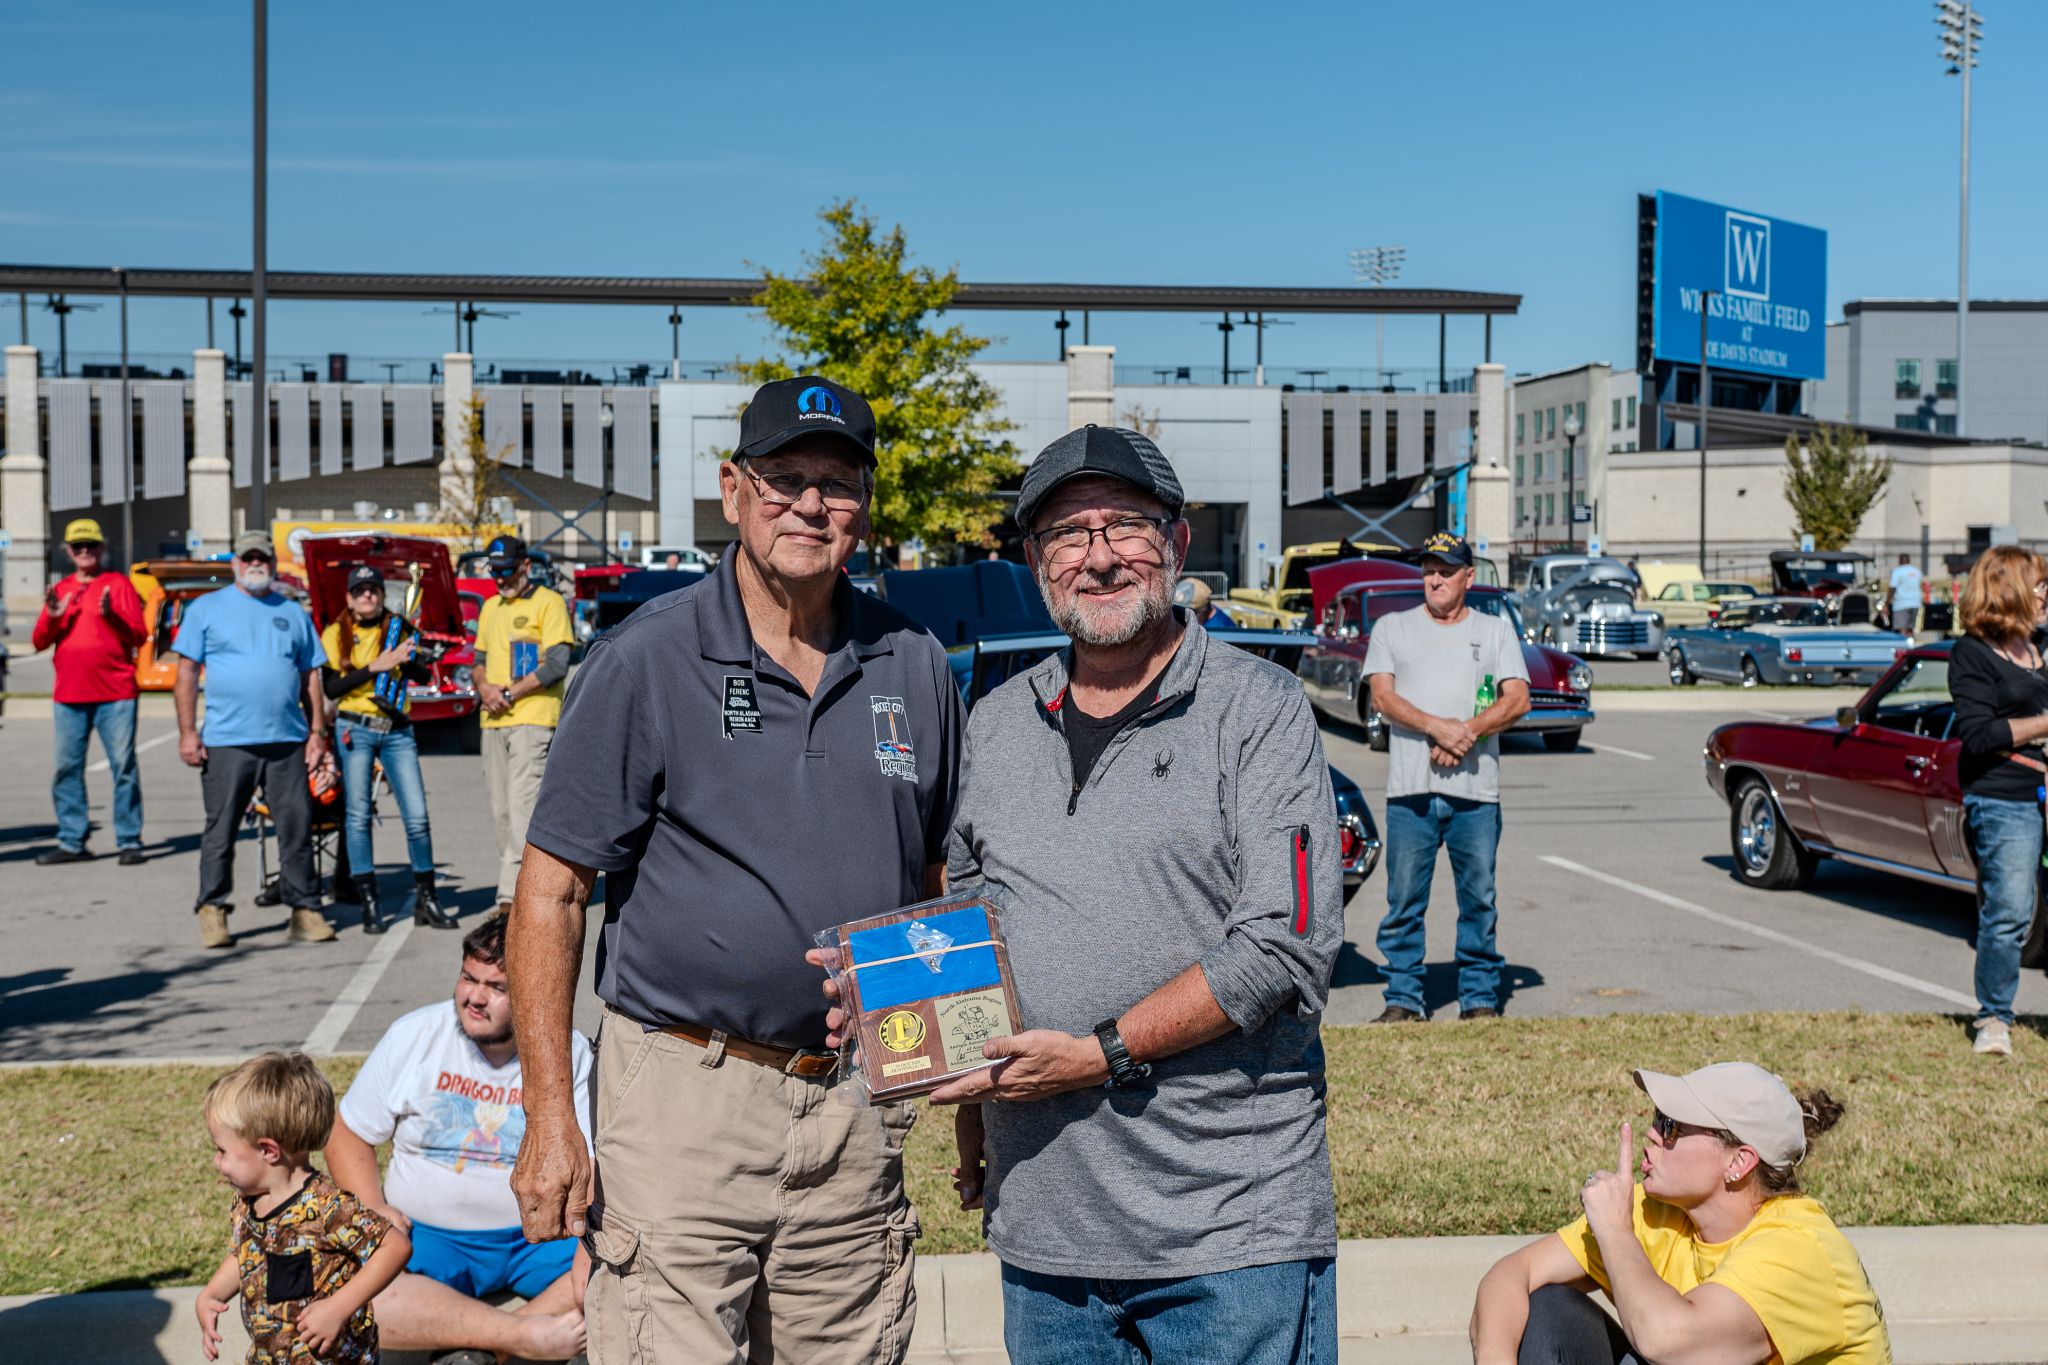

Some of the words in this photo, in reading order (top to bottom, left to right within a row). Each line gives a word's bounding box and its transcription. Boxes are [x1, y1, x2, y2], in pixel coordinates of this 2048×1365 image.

[1731, 225, 1765, 285] W
[1726, 296, 1773, 326] FAMILY
[1775, 304, 1810, 332] FIELD
[1704, 340, 1719, 359] OE
[1748, 346, 1788, 368] STADIUM
[892, 703, 905, 716] CITY
[882, 758, 915, 774] Region
[940, 1003, 955, 1017] North
[955, 996, 982, 1006] Alabama
[982, 995, 1002, 1006] Region
[436, 1071, 505, 1105] DRAGON
